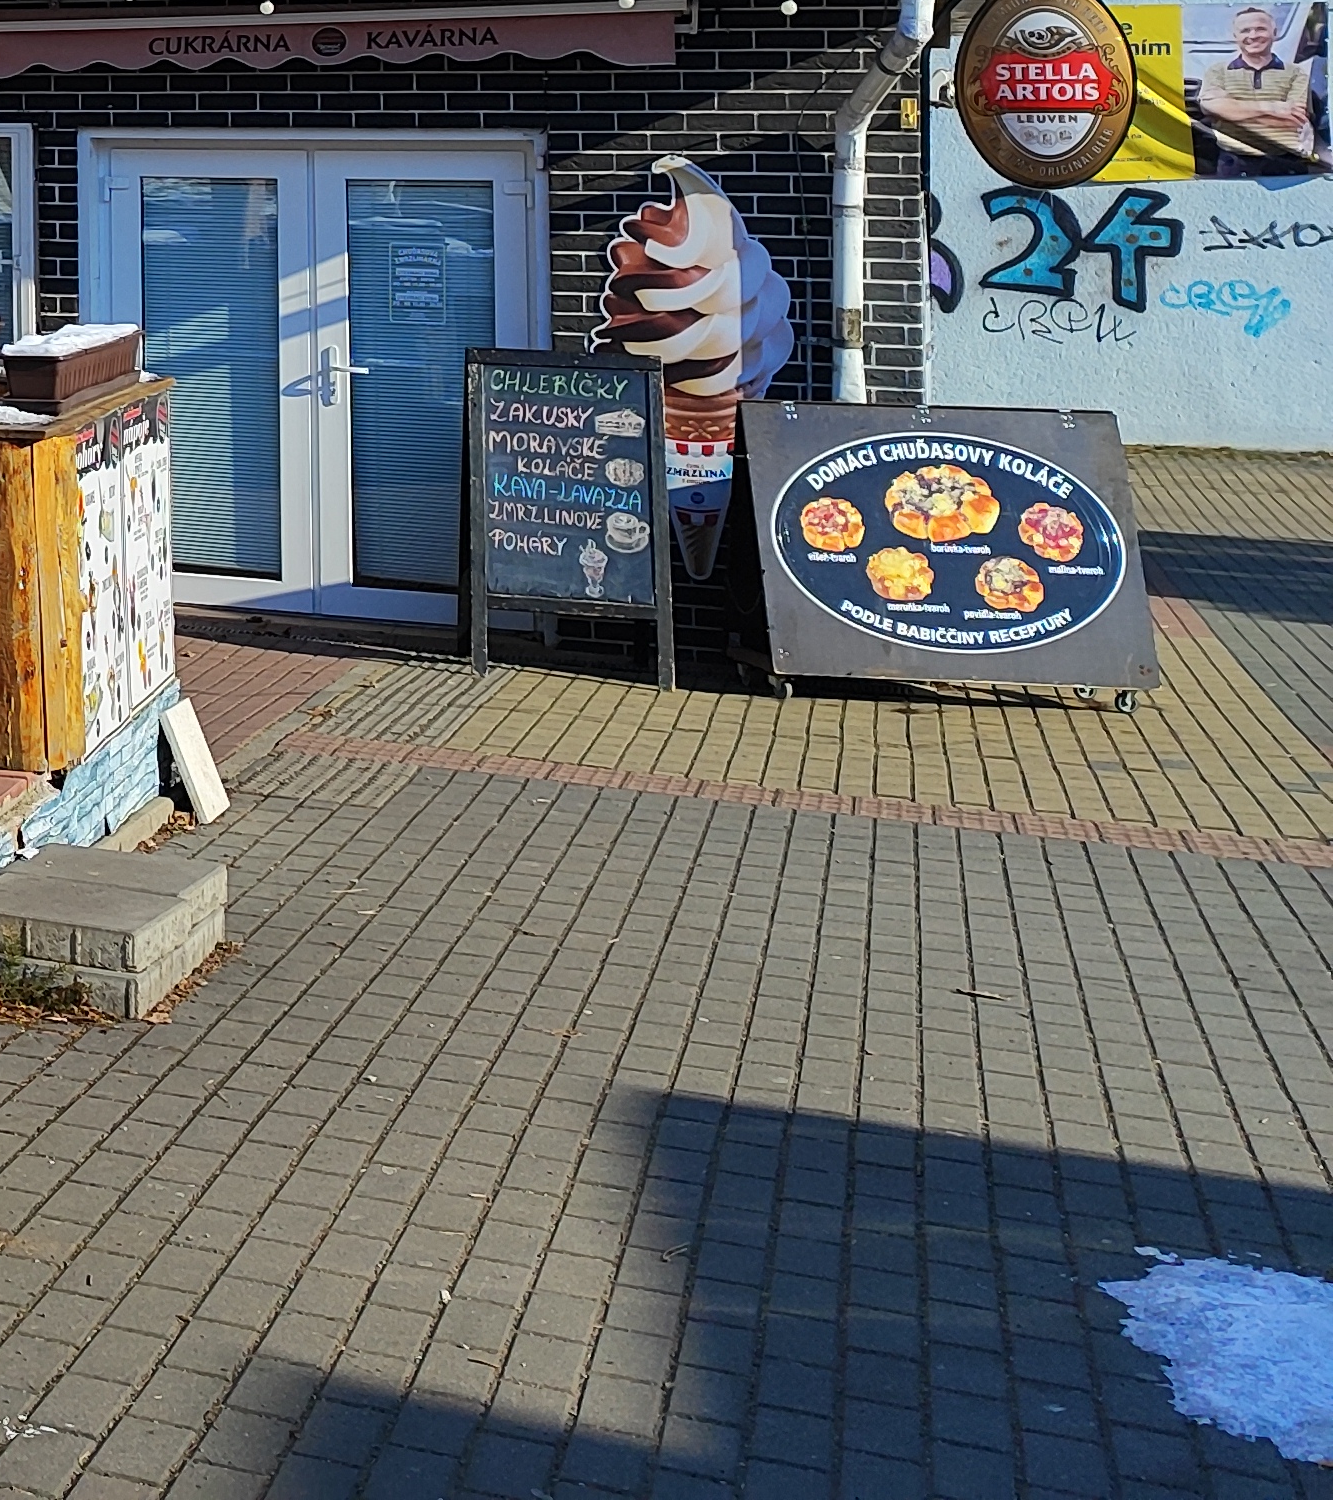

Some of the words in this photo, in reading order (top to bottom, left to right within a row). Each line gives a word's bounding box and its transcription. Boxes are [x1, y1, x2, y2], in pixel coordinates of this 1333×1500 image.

[148, 30, 291, 56] CUKRÁRNA
[366, 25, 499, 50] KAVÁRNA
[995, 63, 1098, 81] STELLA
[994, 83, 1100, 101] ARTOIS
[1016, 114, 1078, 124] LEUVEN
[980, 188, 1183, 313] 24
[490, 369, 629, 400] CHLEBÍČKY
[489, 394, 595, 430] ZÁKUSKY
[488, 430, 610, 459] MORAVSKÉ
[517, 455, 599, 481] KOLÁČE
[666, 466, 727, 478] ZMRZLINA
[805, 444, 877, 492] DOMÁCÍ
[879, 438, 995, 467] CHUĎASOVY
[998, 452, 1074, 500] KOLÁČE
[488, 528, 568, 556] POHÁRY
[840, 599, 894, 632] PODLE
[896, 621, 985, 645] BABIČČINY
[988, 608, 1074, 644] RECEPTURY
